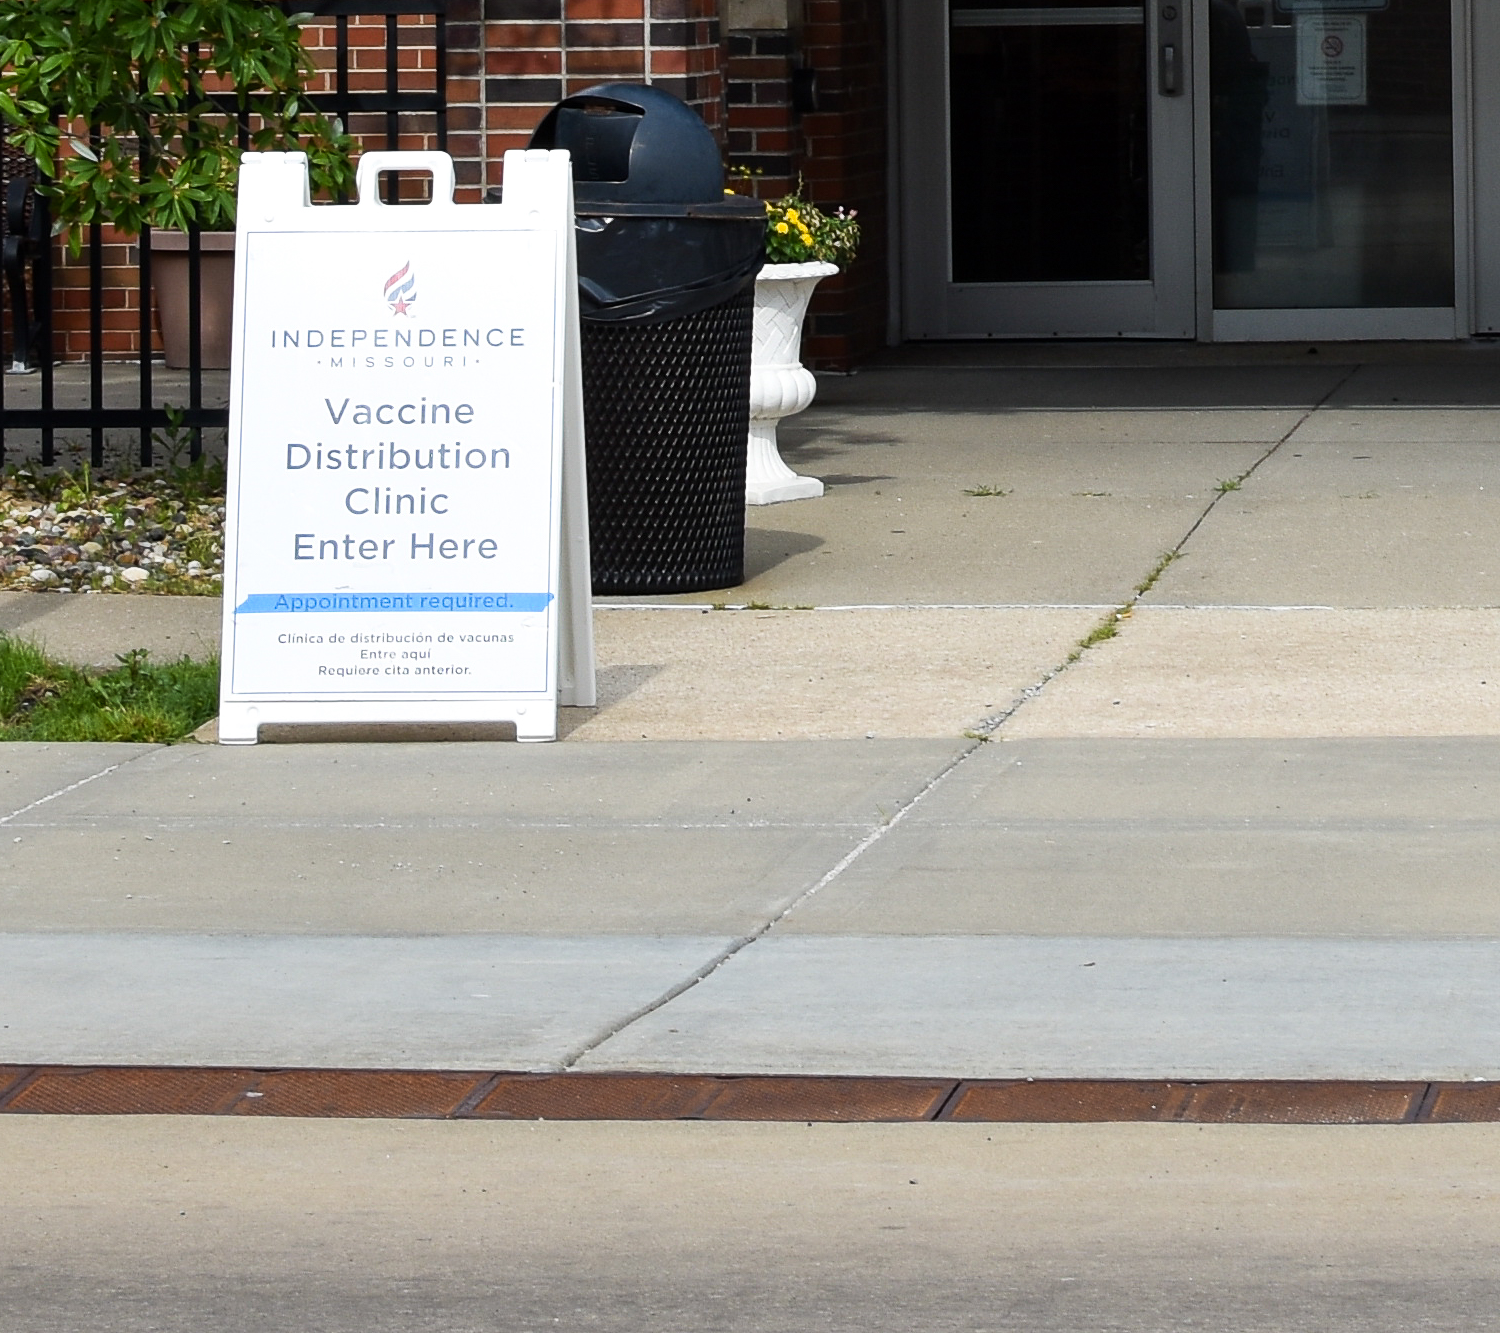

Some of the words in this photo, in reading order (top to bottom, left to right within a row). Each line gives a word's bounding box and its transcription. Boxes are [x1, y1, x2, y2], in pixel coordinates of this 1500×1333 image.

[271, 328, 525, 348] INDEPENDENCE
[330, 356, 467, 368] MISSOURI
[324, 397, 474, 425] Vaccine
[286, 442, 510, 470] Distribution
[345, 486, 448, 515] Clinic
[294, 533, 395, 561] Enter
[410, 532, 498, 560] Here
[274, 593, 413, 612] Appointment
[420, 592, 514, 612] required.
[328, 633, 345, 644] de
[350, 632, 433, 644] distribución
[437, 633, 454, 643] de
[459, 634, 514, 643] vacunas
[360, 649, 397, 660] Entre
[401, 649, 431, 661] aquí
[318, 665, 380, 677] Requiere
[385, 665, 410, 675] cita
[414, 664, 472, 675] anterior.
